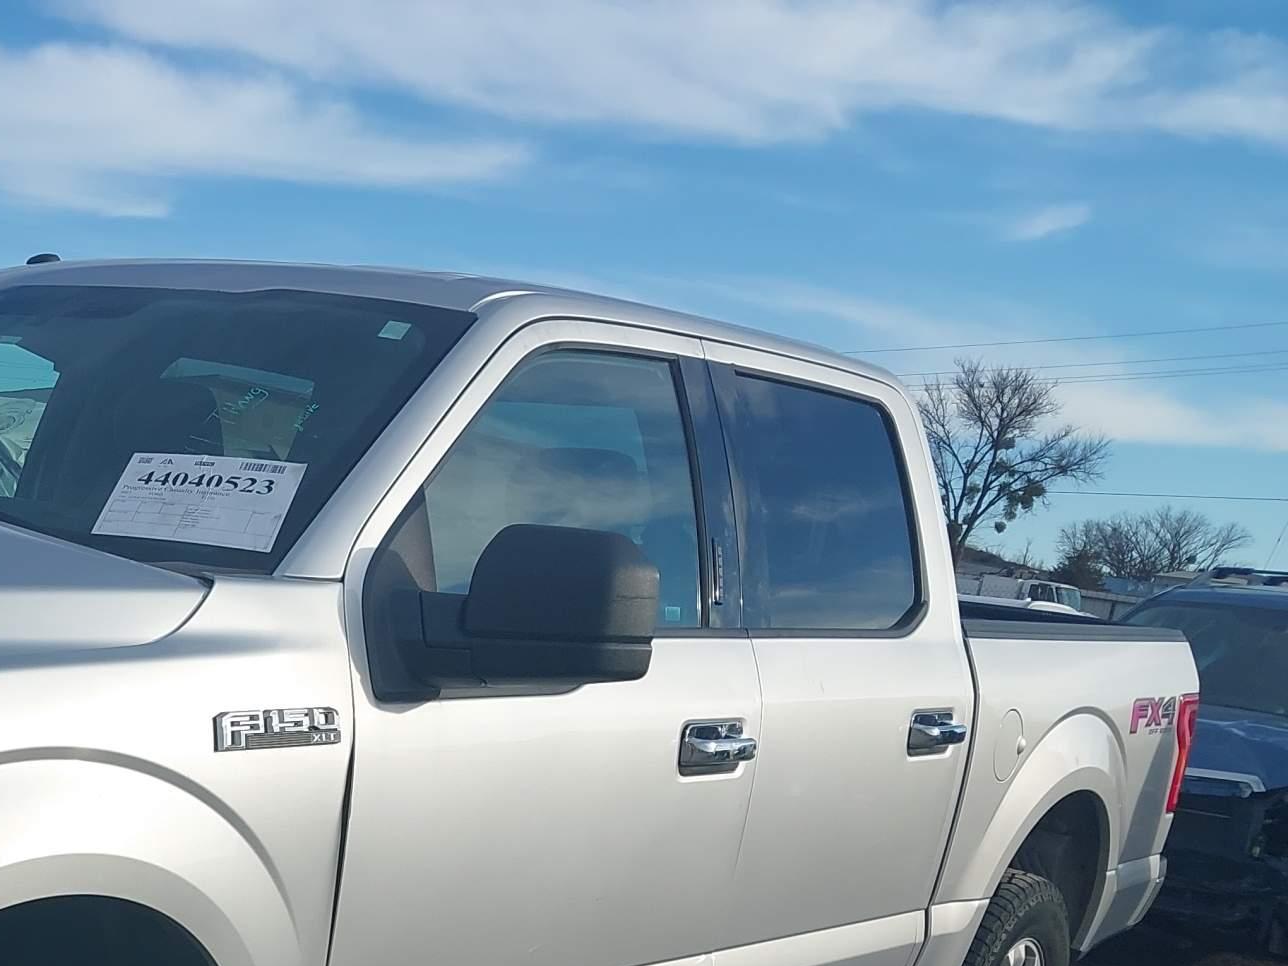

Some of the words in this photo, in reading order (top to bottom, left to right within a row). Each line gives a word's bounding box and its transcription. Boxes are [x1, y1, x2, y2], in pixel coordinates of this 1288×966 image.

[123, 484, 163, 493] Progressive
[137, 470, 275, 496] 44040523
[1129, 696, 1177, 735] FX4
[312, 732, 337, 742] XLT
